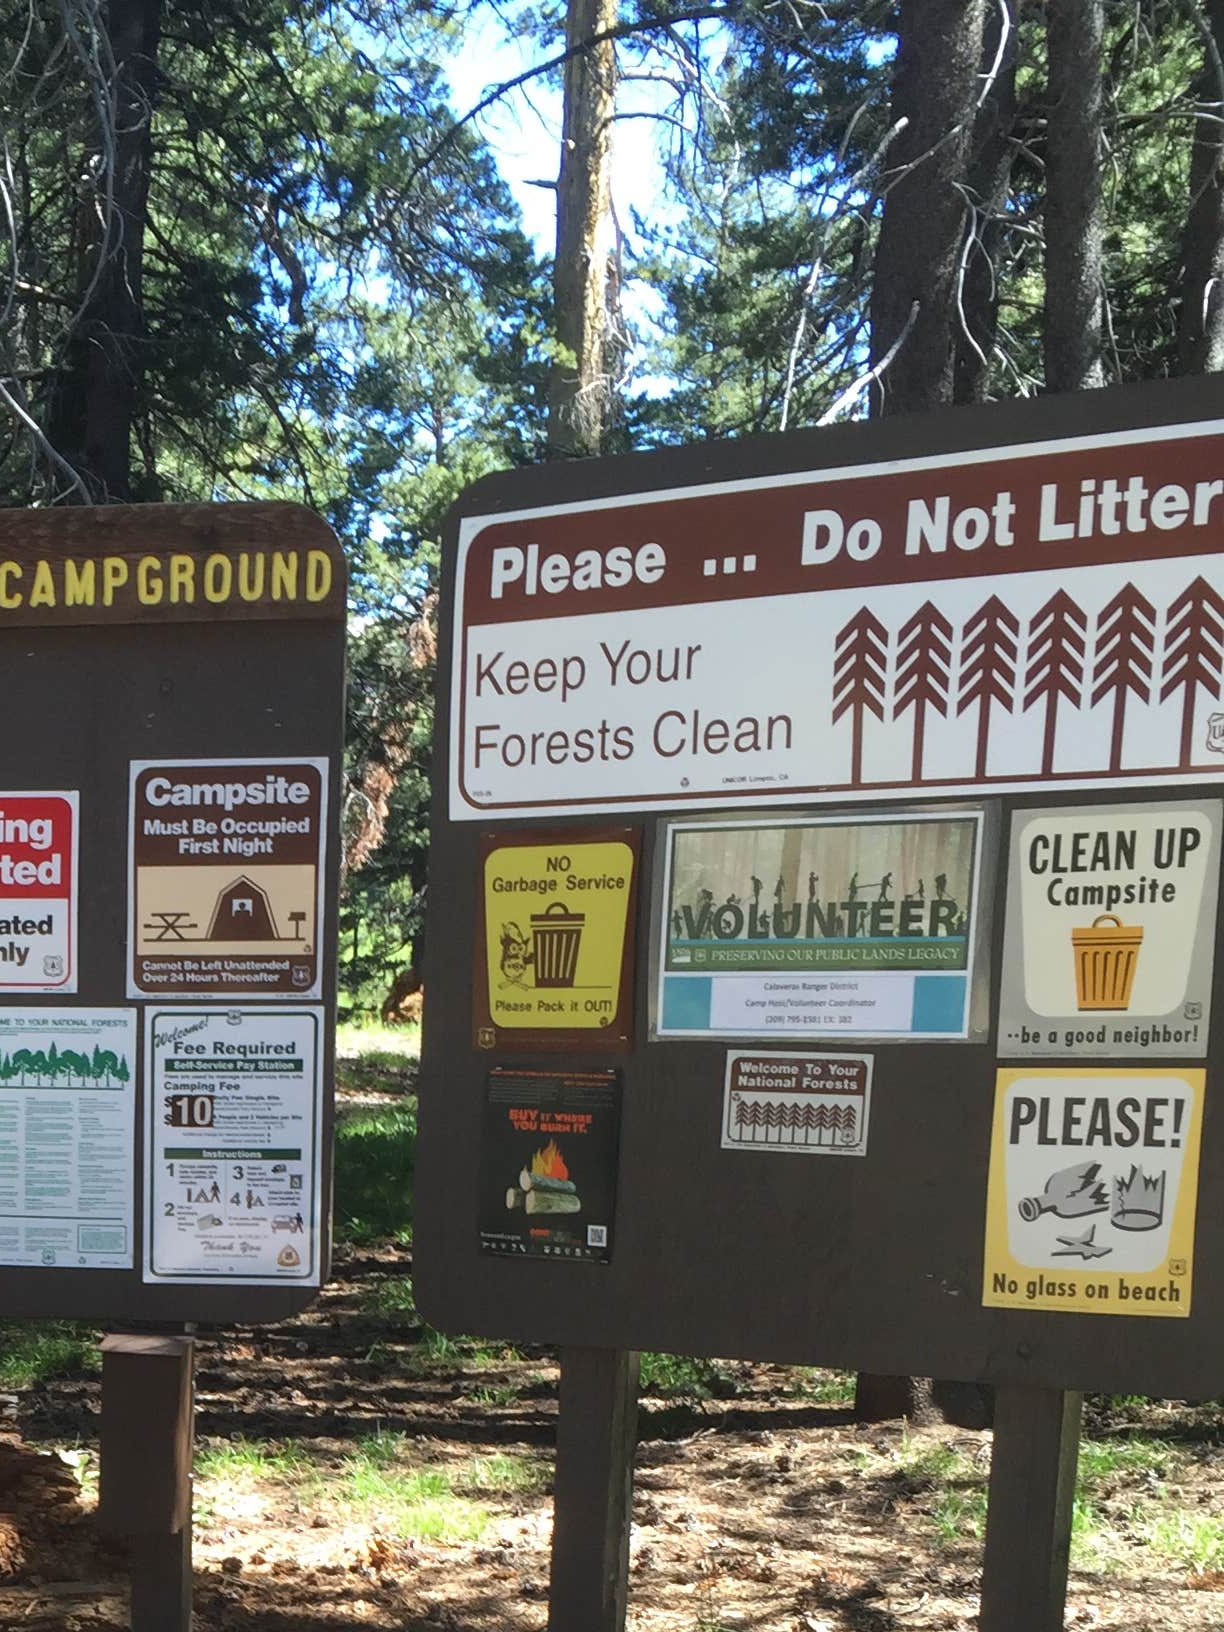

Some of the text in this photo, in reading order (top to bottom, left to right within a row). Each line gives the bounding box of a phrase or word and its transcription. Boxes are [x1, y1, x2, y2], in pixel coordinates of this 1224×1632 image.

[491, 476, 1224, 599] Please Do Not Litter
[476, 640, 702, 702] Keep Your
[475, 710, 792, 768] Forests Clean
[146, 775, 310, 811] Campsite
[144, 817, 309, 837] Must Be Occupied
[179, 837, 273, 857] First Night
[1029, 827, 1201, 874] CLEAN UP
[546, 856, 570, 872] NO
[492, 874, 625, 894] Garbage Service
[1047, 876, 1176, 911] Campsite
[682, 900, 959, 939] VOLUNTEER
[711, 948, 960, 961] PRESERVING OUR PUBLIC LANDS LEGACY
[143, 960, 289, 971] Cannot Be Left Unattended
[143, 972, 280, 983] Over 24 Hours Thereafter
[496, 1000, 612, 1011] Please Pack it OUT!
[1048, 1029, 1057, 1043] a
[1067, 1026, 1106, 1047] good
[1113, 1025, 1198, 1047] neighbor!
[173, 1042, 296, 1057] Fee Required
[740, 1062, 859, 1076] Welcome To Your
[164, 1082, 240, 1092] Camping Fee
[738, 1075, 857, 1090] National Forests
[1009, 1097, 1185, 1148] PLEASE!
[993, 1273, 1180, 1302] No glass on beach
